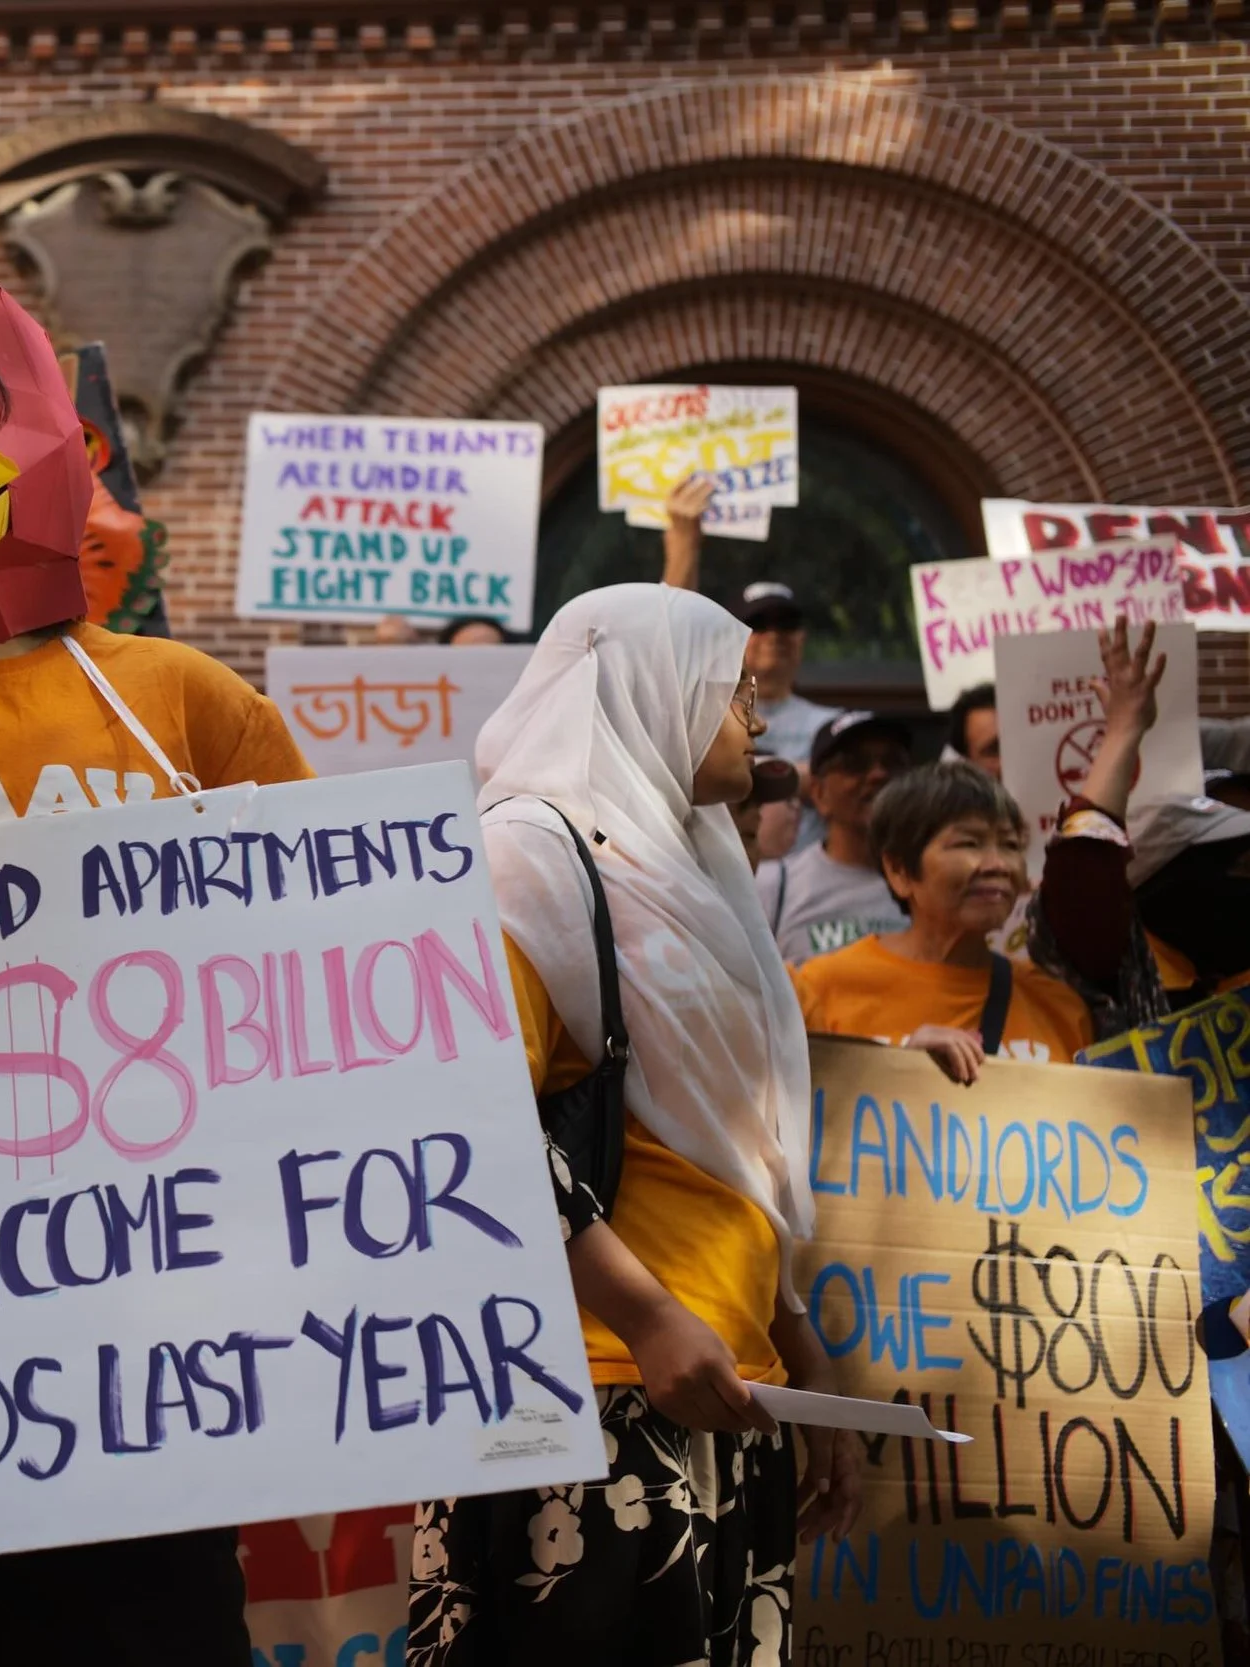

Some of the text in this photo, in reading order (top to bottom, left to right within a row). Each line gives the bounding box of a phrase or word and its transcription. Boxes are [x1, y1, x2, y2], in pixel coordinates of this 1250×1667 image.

[262, 425, 535, 455] WHEN TENANTS
[278, 462, 468, 494] ARE UNDER
[300, 495, 455, 533] ATTACK
[272, 527, 468, 565] STAND UP
[272, 567, 512, 607] FIGHT BACK
[291, 674, 461, 748] ভাড়া
[1028, 699, 1093, 725] DON'T
[82, 813, 473, 918] APARTMENTS
[811, 1087, 1149, 1220] LANDLORDS
[278, 1132, 523, 1268] FOR
[810, 1218, 1195, 1409] OWE $800
[98, 1331, 295, 1454] LAST
[301, 1294, 584, 1444] YEAR
[810, 1531, 1216, 1627] IN UNPAID FINES
